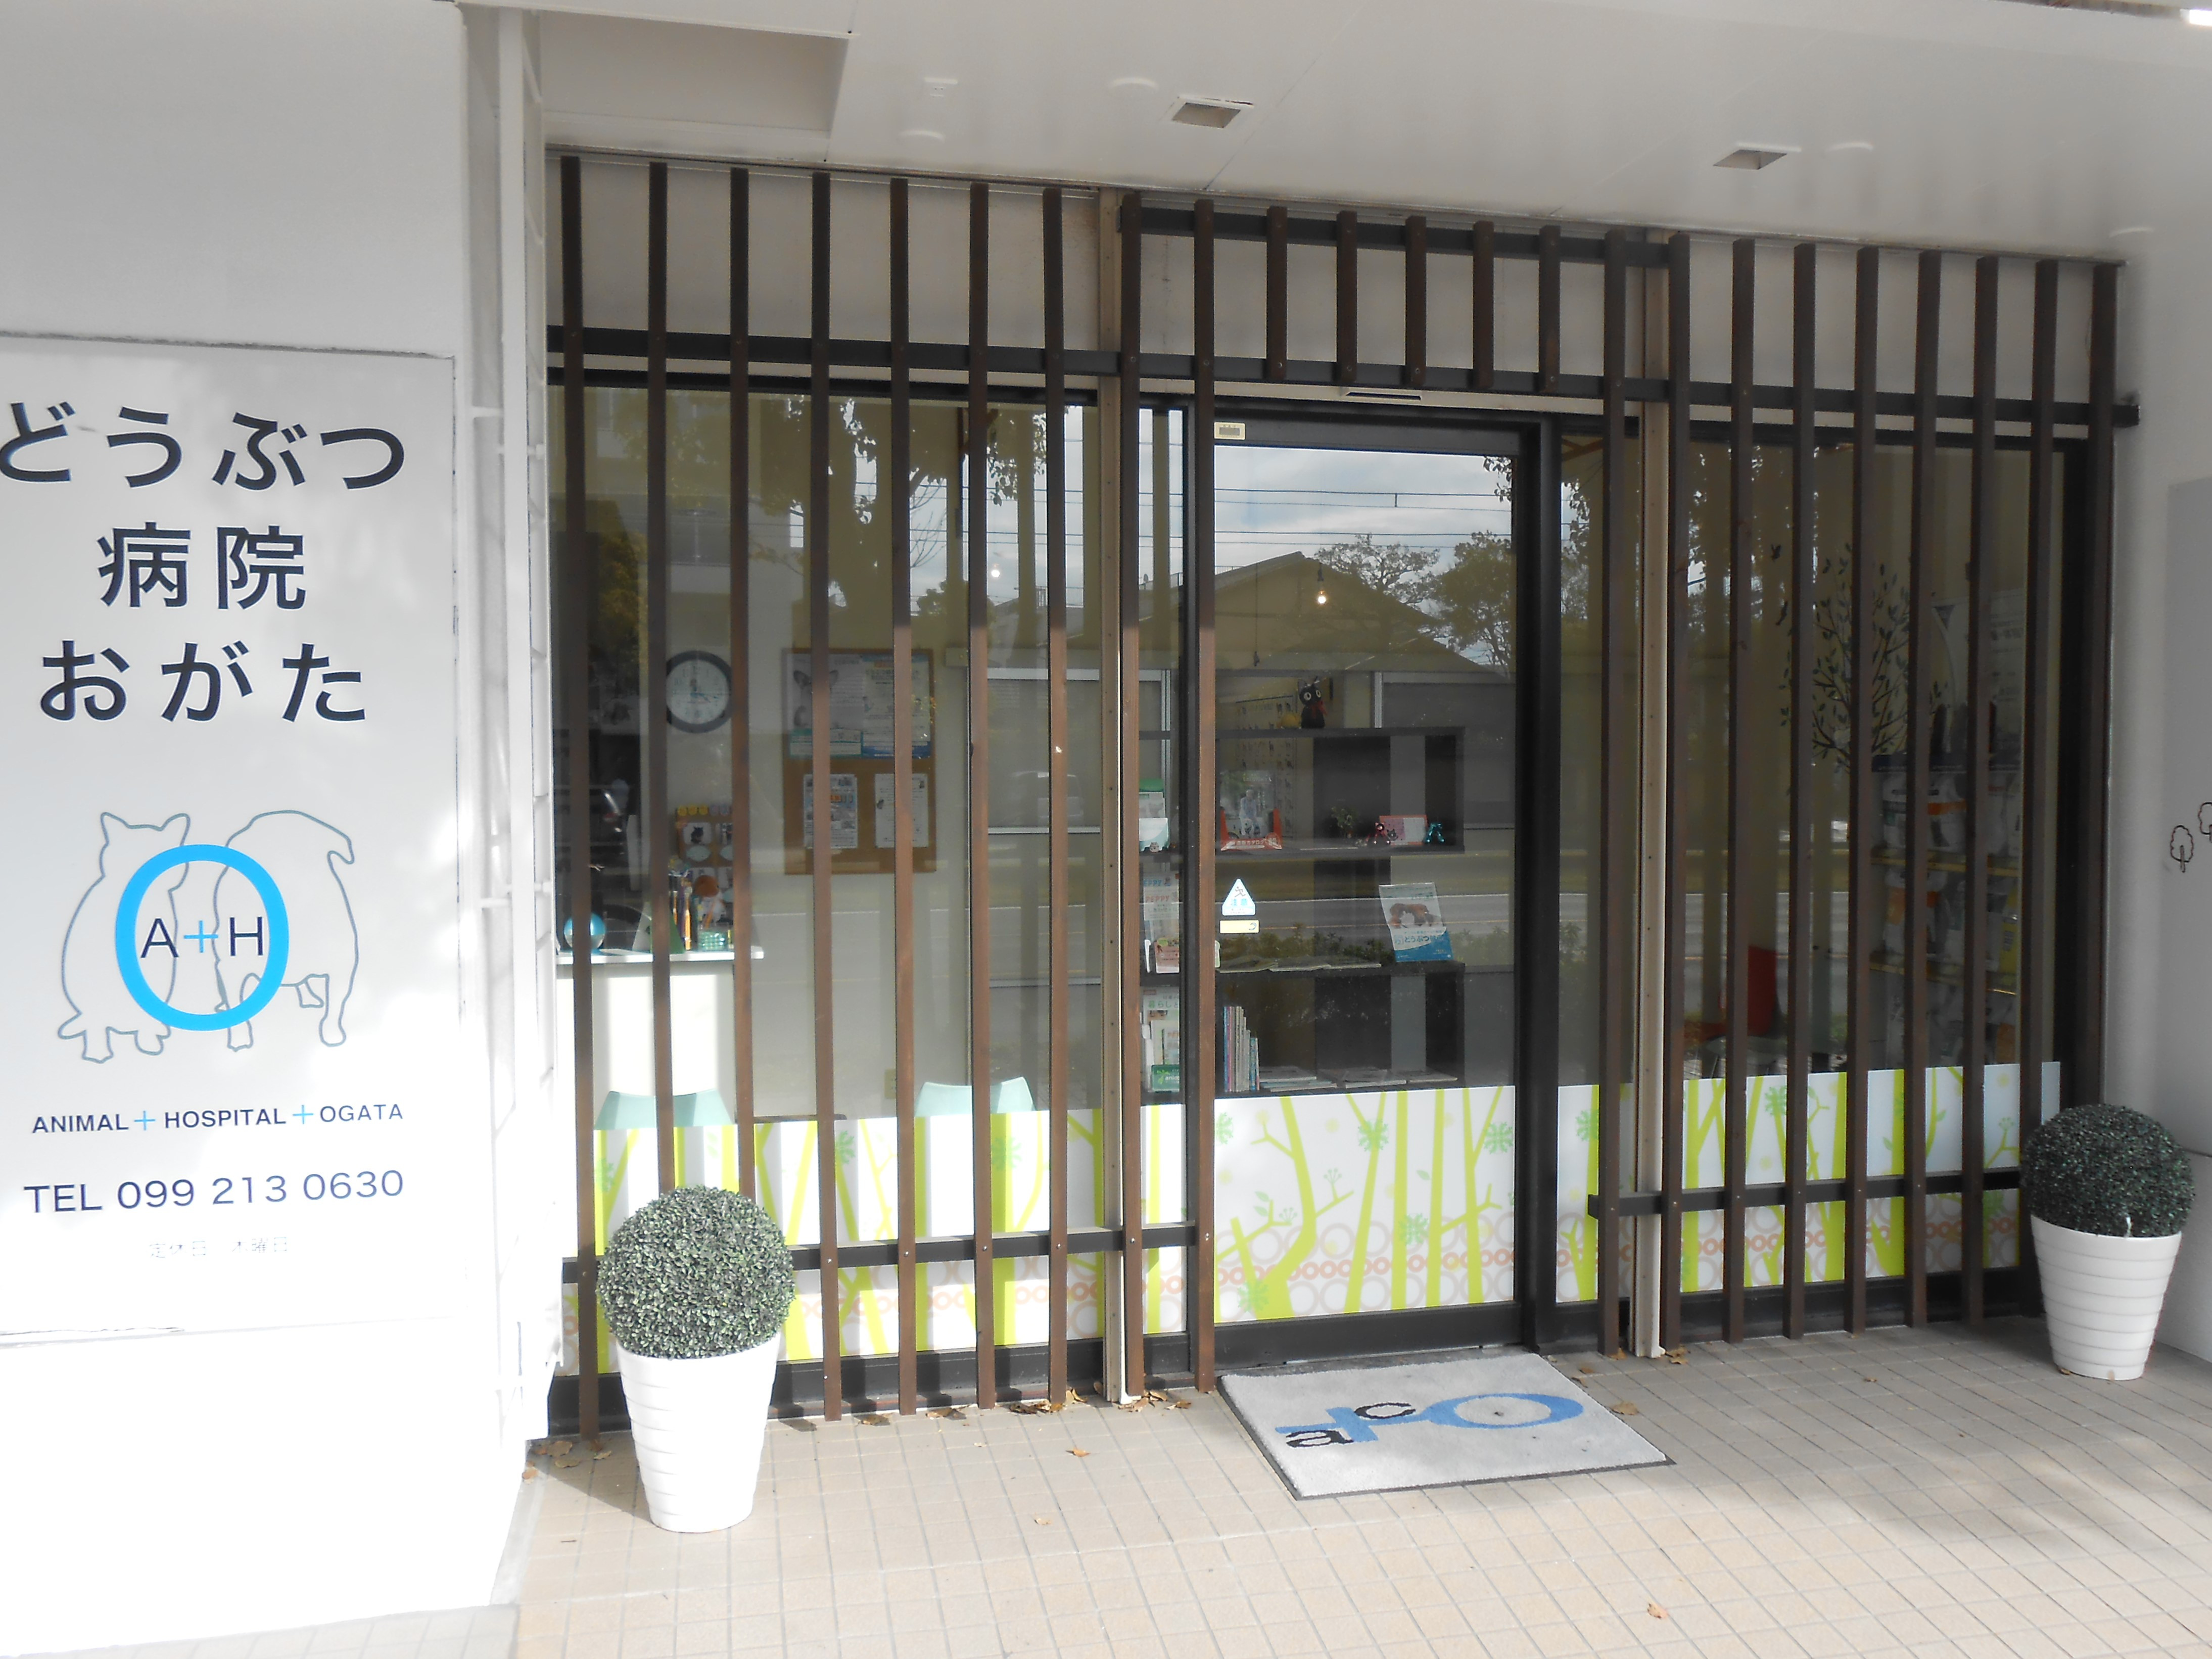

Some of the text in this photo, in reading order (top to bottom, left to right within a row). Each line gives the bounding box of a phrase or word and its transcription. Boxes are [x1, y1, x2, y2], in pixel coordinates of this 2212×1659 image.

[0, 402, 404, 490] どうぶつ
[97, 522, 306, 609] 病院
[40, 640, 365, 722] おがた
[32, 1114, 129, 1133] ANIMAL
[164, 1108, 287, 1129] HOSPITAL
[320, 1104, 403, 1123] OGATA
[24, 1169, 404, 1213] TEL 099 213 0630
